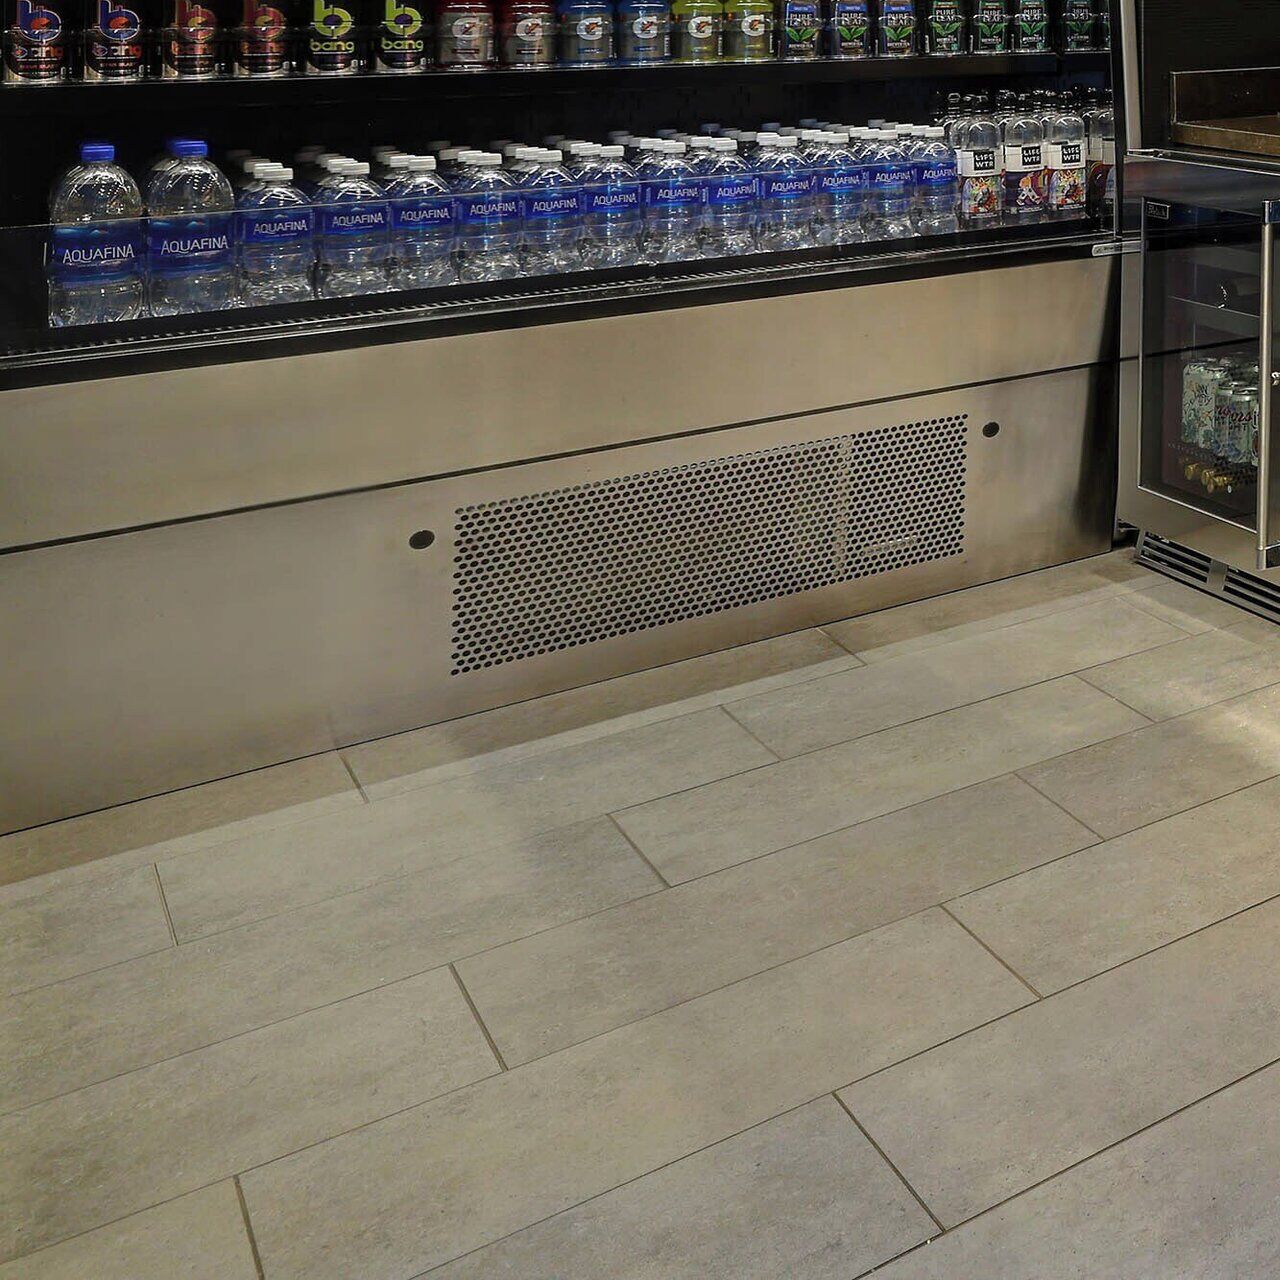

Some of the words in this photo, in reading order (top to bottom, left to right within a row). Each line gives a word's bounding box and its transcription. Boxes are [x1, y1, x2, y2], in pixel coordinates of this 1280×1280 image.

[310, 39, 354, 53] bang
[381, 37, 424, 52] bang
[974, 151, 996, 161] LIFE
[1022, 148, 1041, 156] LIFE
[1062, 146, 1081, 154] LIFE
[974, 160, 996, 170] WTR
[1022, 156, 1041, 164] WTR
[1062, 154, 1081, 163] WTR
[822, 174, 862, 191] AQUAFINA
[874, 168, 915, 185] AQUAFINA
[656, 186, 699, 201] AQUAFINA
[770, 179, 811, 195] AQUAFINA
[469, 200, 517, 214] AQUAFINA
[531, 197, 578, 213] AQUAFINA
[592, 192, 637, 208] AQUAFINA
[331, 211, 384, 227] AQUAFINA
[400, 206, 451, 223] AQUAFINA
[252, 218, 308, 238] AQUAFINA
[160, 234, 229, 256] AQUAFINA
[62, 242, 135, 264] AQUAFINA
